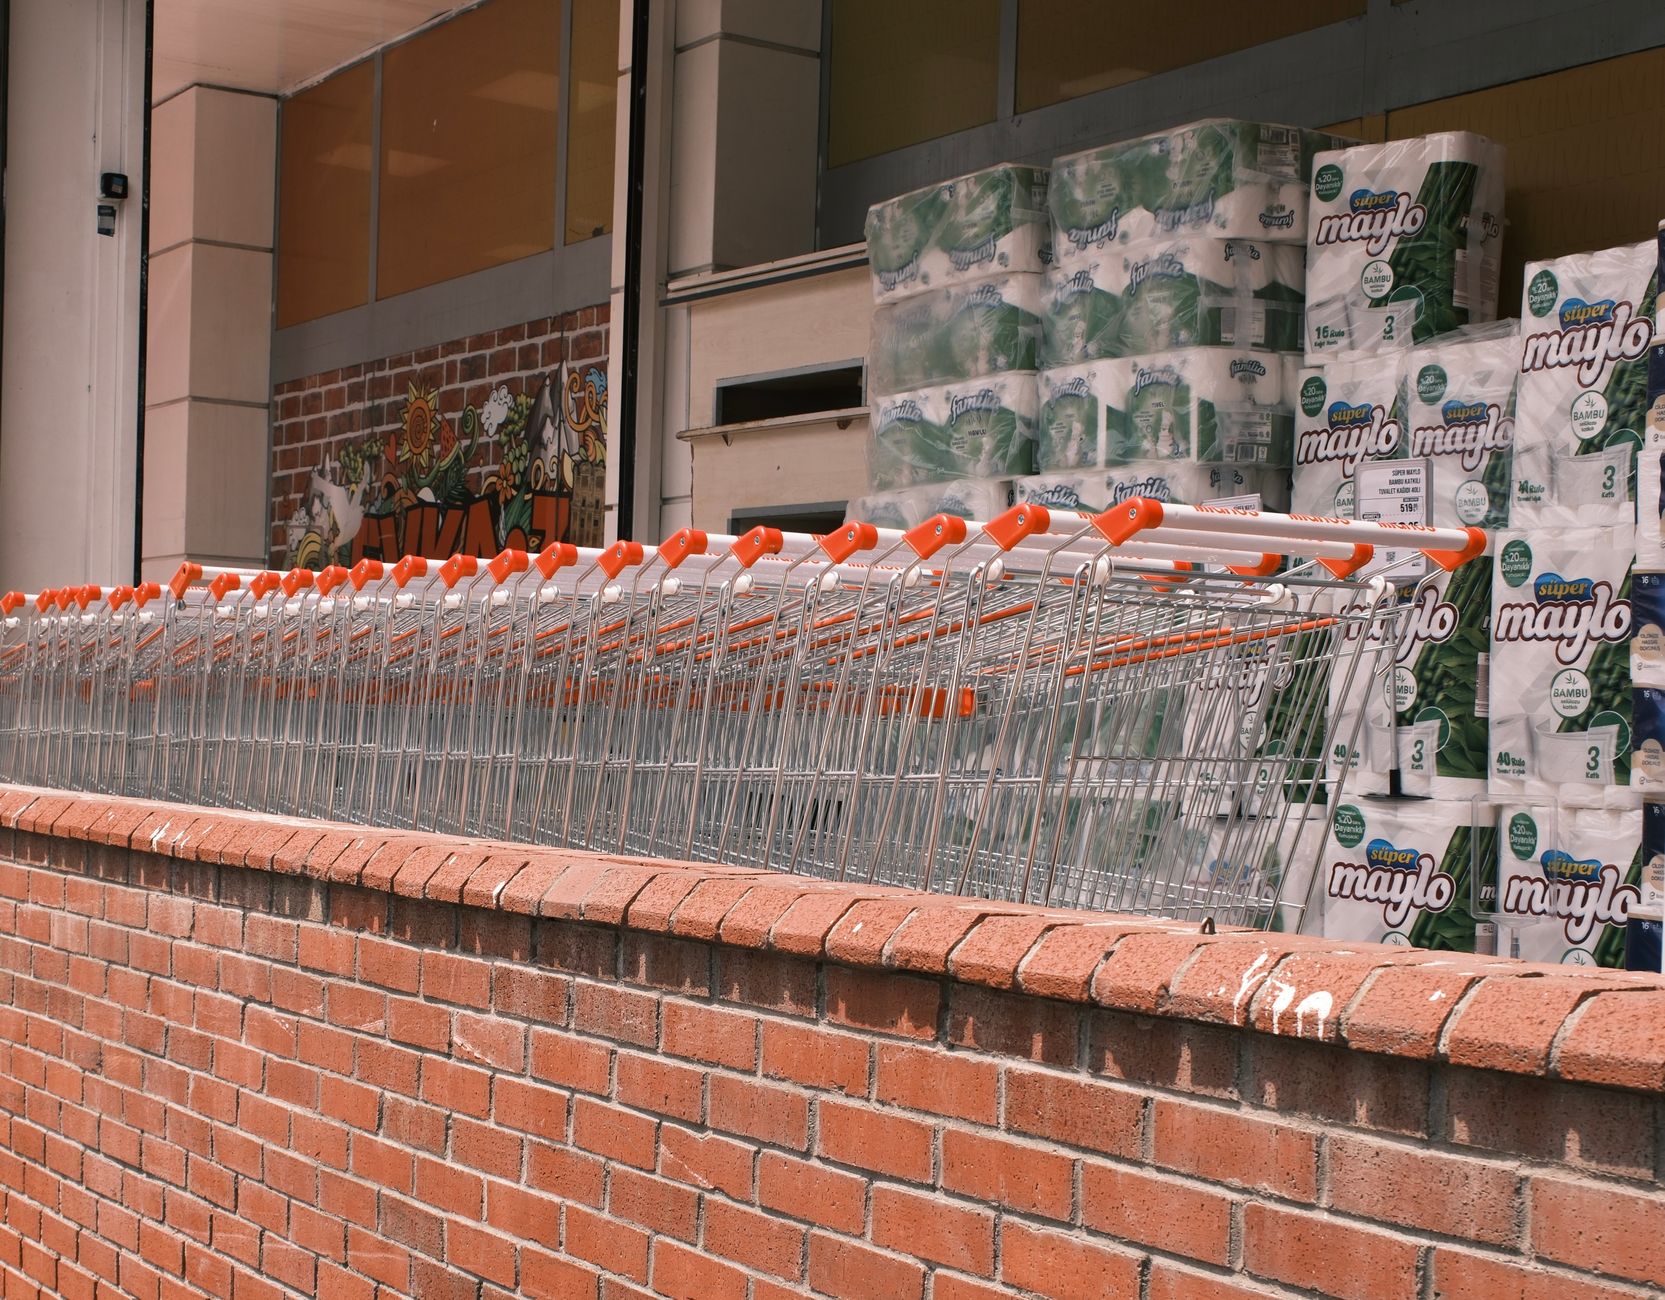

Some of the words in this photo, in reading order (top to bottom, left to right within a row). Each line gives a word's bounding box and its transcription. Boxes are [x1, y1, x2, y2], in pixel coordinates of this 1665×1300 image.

[1353, 194, 1394, 208] süper
[1316, 191, 1427, 257] maylo
[1364, 275, 1391, 285] BAMBU
[1563, 302, 1609, 324] süper
[1315, 326, 1329, 339] 16
[1384, 315, 1395, 335] 3
[1521, 300, 1654, 388] maylo
[1331, 406, 1370, 423] süper
[1446, 406, 1484, 420] süper
[1573, 409, 1605, 421] BAMBU
[1296, 404, 1403, 479] maylo
[1411, 403, 1516, 473] maylo
[1602, 465, 1616, 491] 3
[1400, 503, 1413, 512] 519
[1458, 496, 1486, 508] BAMBU
[1538, 579, 1588, 599] süper
[1641, 575, 1649, 584] 16
[1495, 581, 1632, 666] maylo
[1553, 688, 1588, 699] BAMBU
[1334, 744, 1346, 758] 40
[1411, 739, 1424, 763] 3
[1497, 751, 1511, 766] 40
[1511, 757, 1526, 767] Rulo
[1586, 745, 1600, 771] 3
[1370, 847, 1415, 865] süper
[1546, 857, 1598, 878] süper
[1328, 853, 1457, 929] maylo
[1503, 863, 1643, 946] maylo
[1641, 921, 1650, 931] 16
